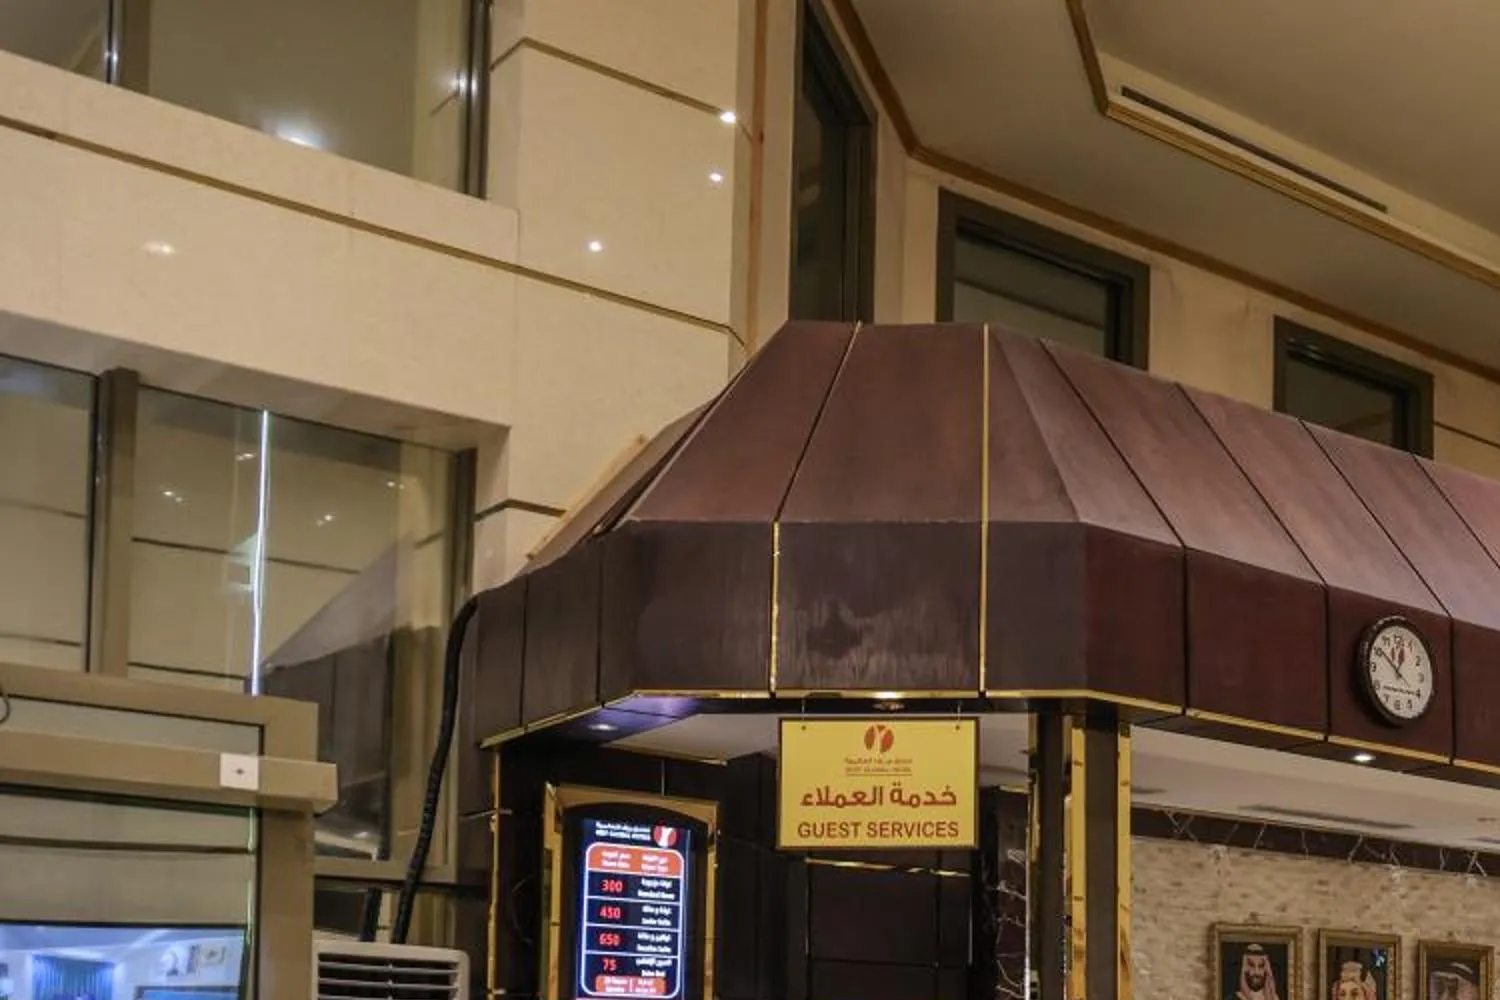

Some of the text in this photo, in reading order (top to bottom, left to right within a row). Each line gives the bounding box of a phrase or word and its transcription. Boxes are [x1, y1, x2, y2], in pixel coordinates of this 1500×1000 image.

[800, 782, 957, 809] خدمة العملاء
[797, 820, 959, 839] GUEST SERVICES
[601, 879, 623, 893] 300
[599, 905, 621, 919] 450
[602, 958, 617, 971] 75
